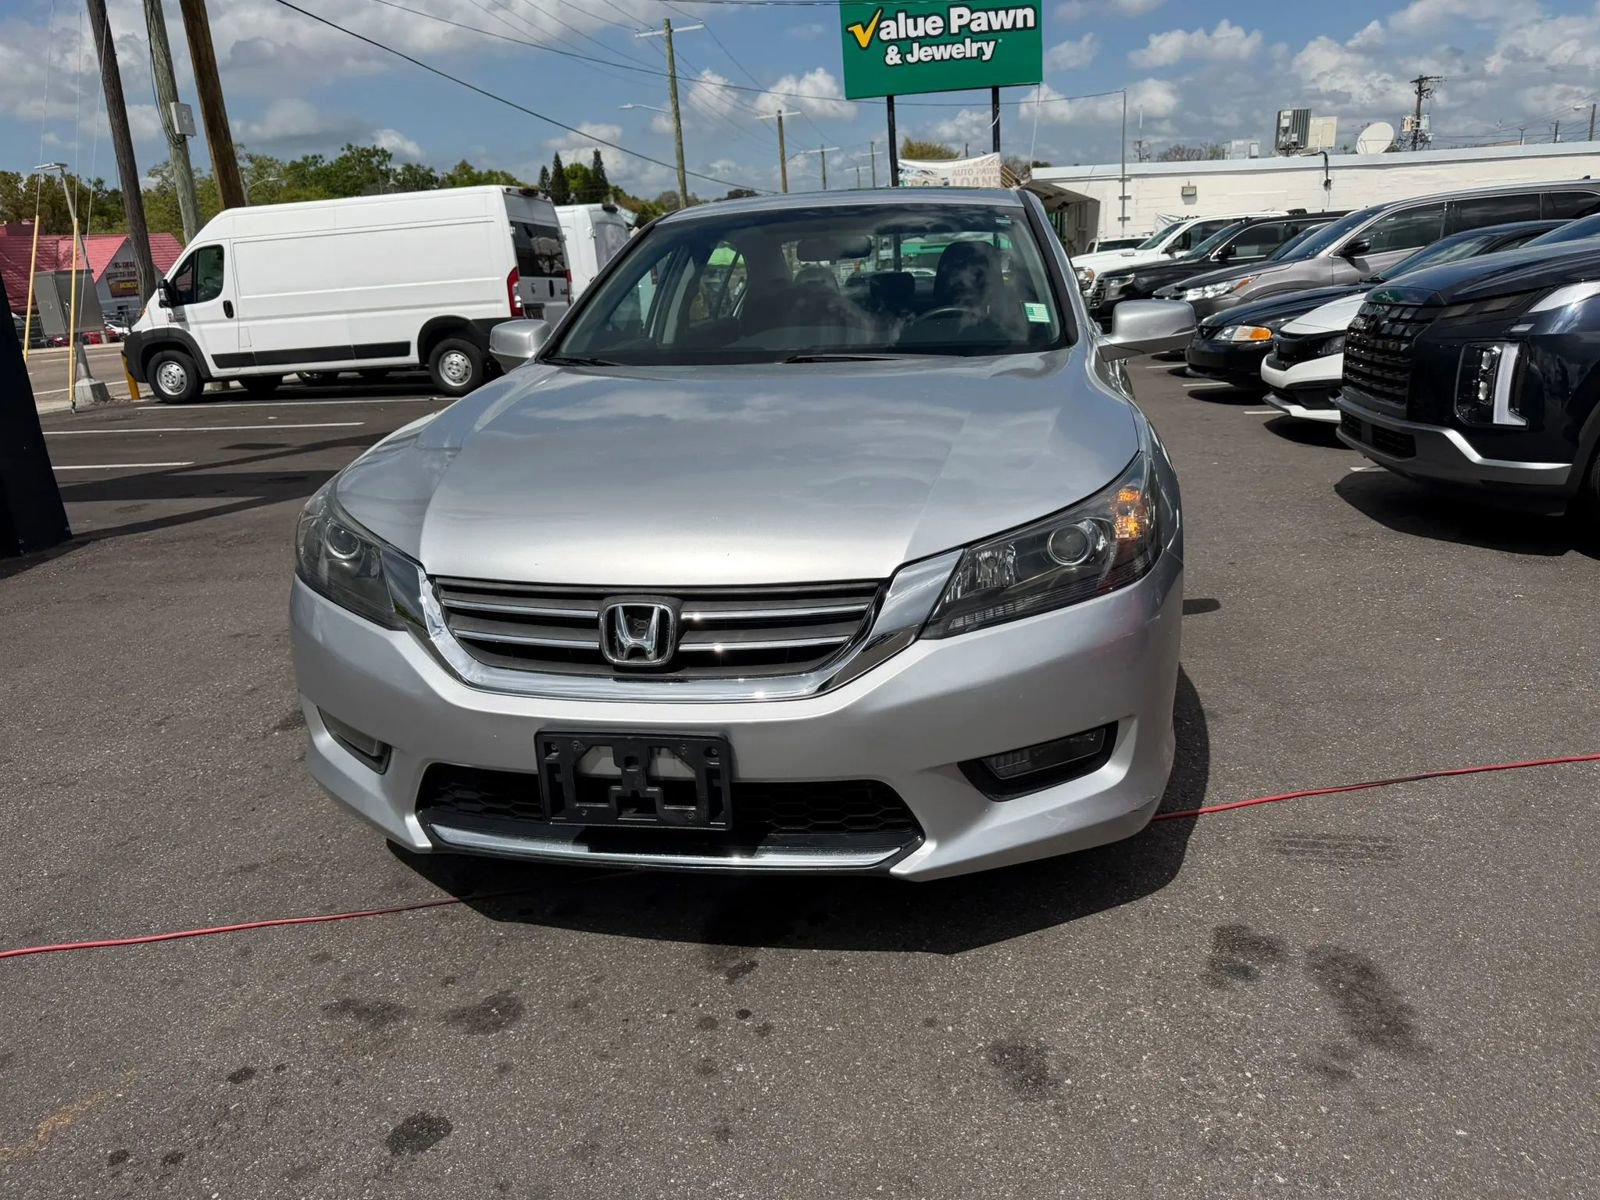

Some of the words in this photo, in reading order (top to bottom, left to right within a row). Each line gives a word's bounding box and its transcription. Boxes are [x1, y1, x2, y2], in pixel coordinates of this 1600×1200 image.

[949, 6, 1036, 34] Pawn
[884, 44, 903, 66] &
[905, 38, 996, 64] Jewelry
[952, 168, 974, 177] AUTO
